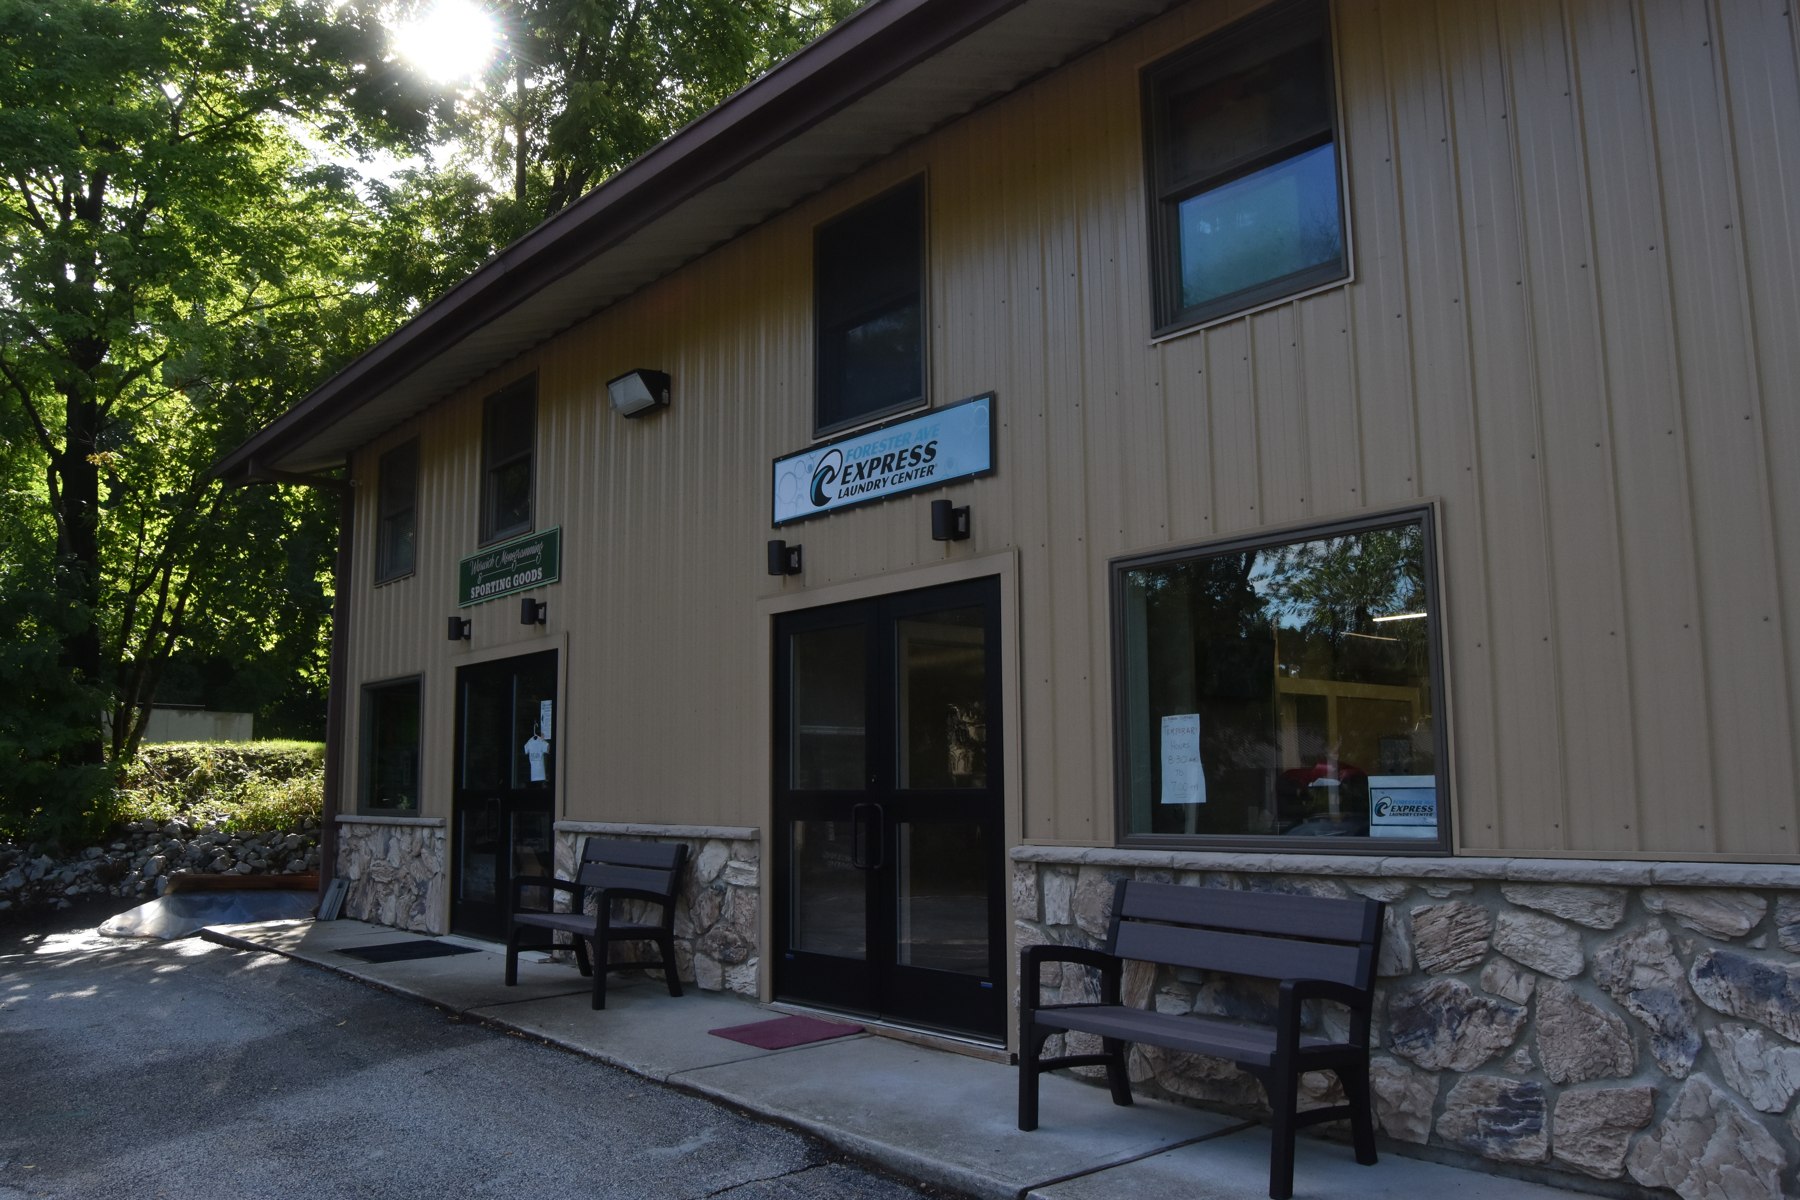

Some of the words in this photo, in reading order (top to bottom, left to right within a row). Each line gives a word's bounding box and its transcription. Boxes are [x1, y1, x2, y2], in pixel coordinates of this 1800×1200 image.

[846, 433, 911, 461] FORESTER
[913, 423, 941, 445] AVE
[840, 440, 938, 486] EXPRESS
[837, 475, 889, 499] LAUNDRY
[890, 464, 935, 487] CENTER
[470, 576, 512, 599] SPORTING
[513, 567, 543, 586] GOODS
[1390, 805, 1434, 813] EXPRESS
